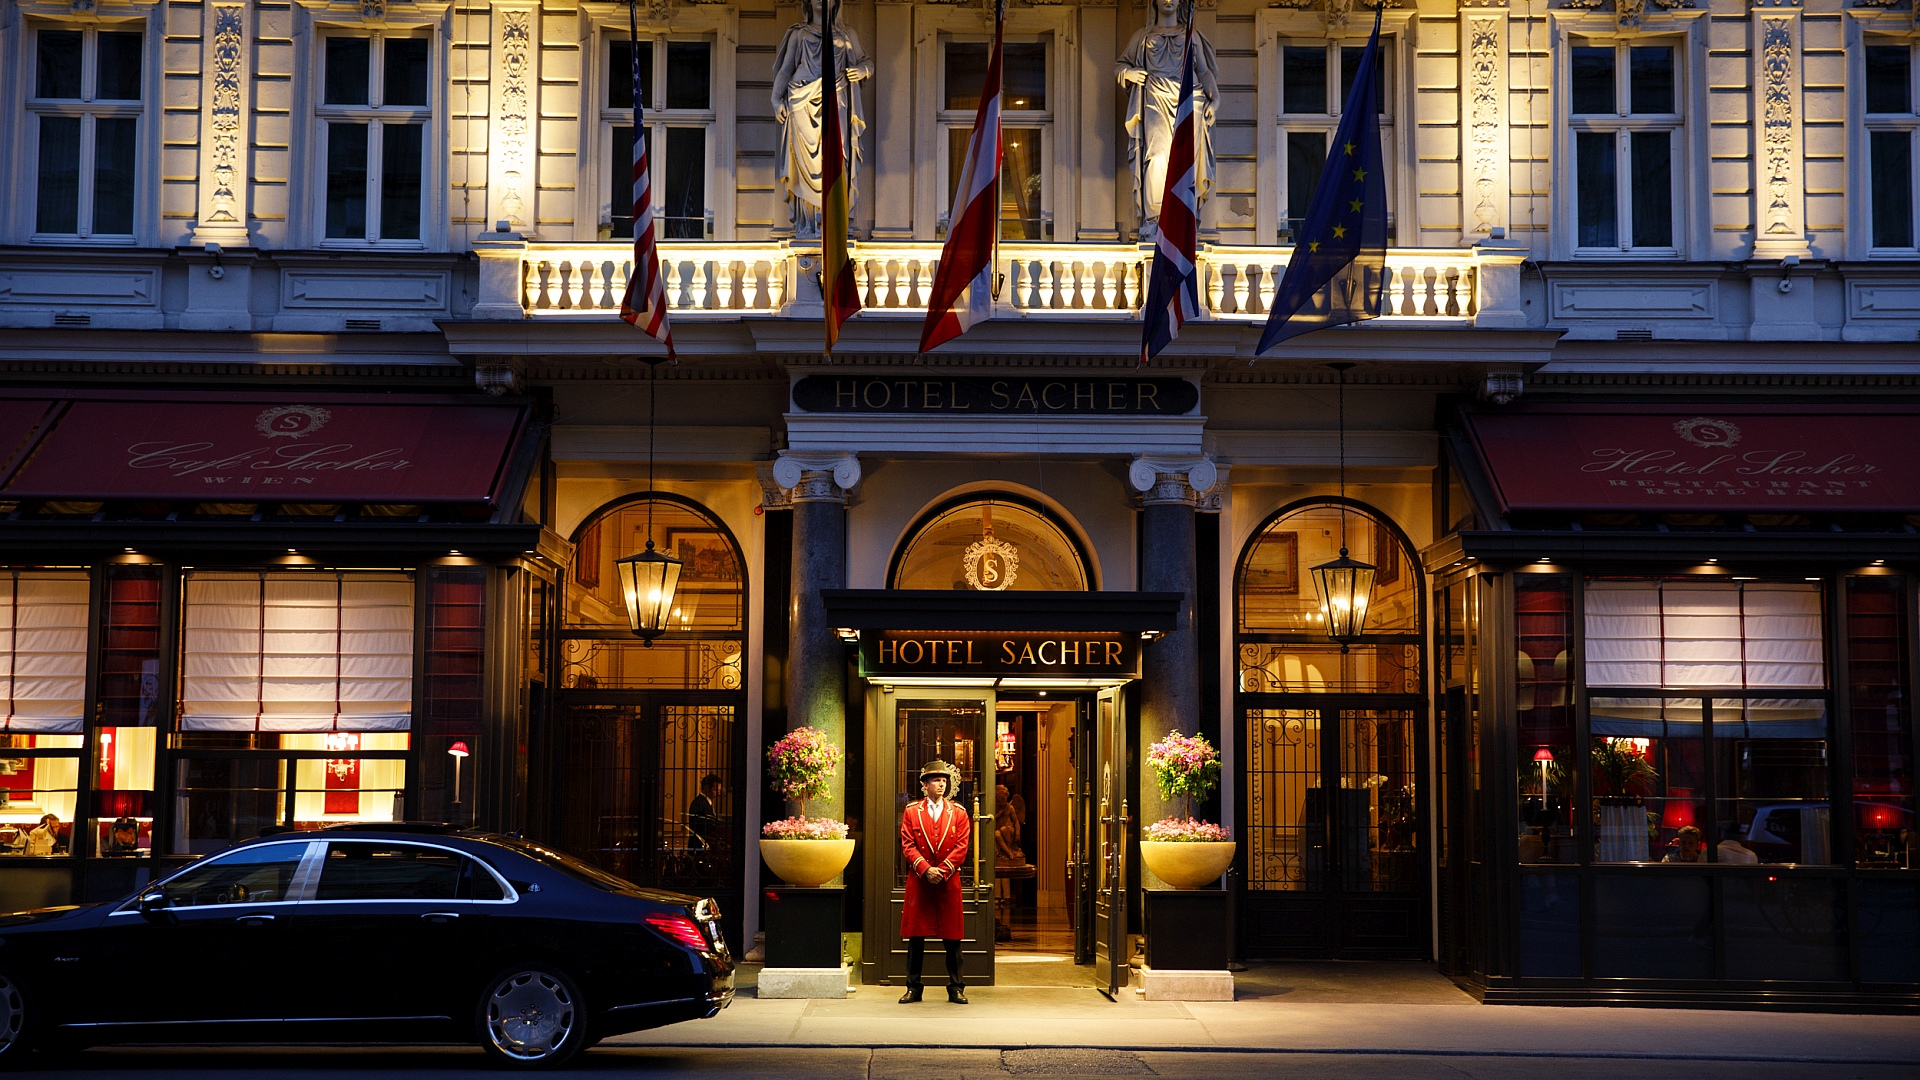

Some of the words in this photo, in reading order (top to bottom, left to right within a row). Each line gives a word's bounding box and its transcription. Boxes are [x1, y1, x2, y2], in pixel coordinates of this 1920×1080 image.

[990, 381, 1161, 411] SACHER
[127, 441, 270, 477] Café
[250, 443, 414, 471] Sacher
[1580, 448, 1737, 475] Hotel
[1736, 450, 1882, 475] Sacher
[202, 476, 316, 485] WIEN
[1607, 479, 1873, 489] RESTAURANT
[1646, 488, 1746, 496] ROTE
[1766, 488, 1845, 496] BAR
[878, 639, 983, 665] HOTEL
[1000, 640, 1124, 666] SACHER
